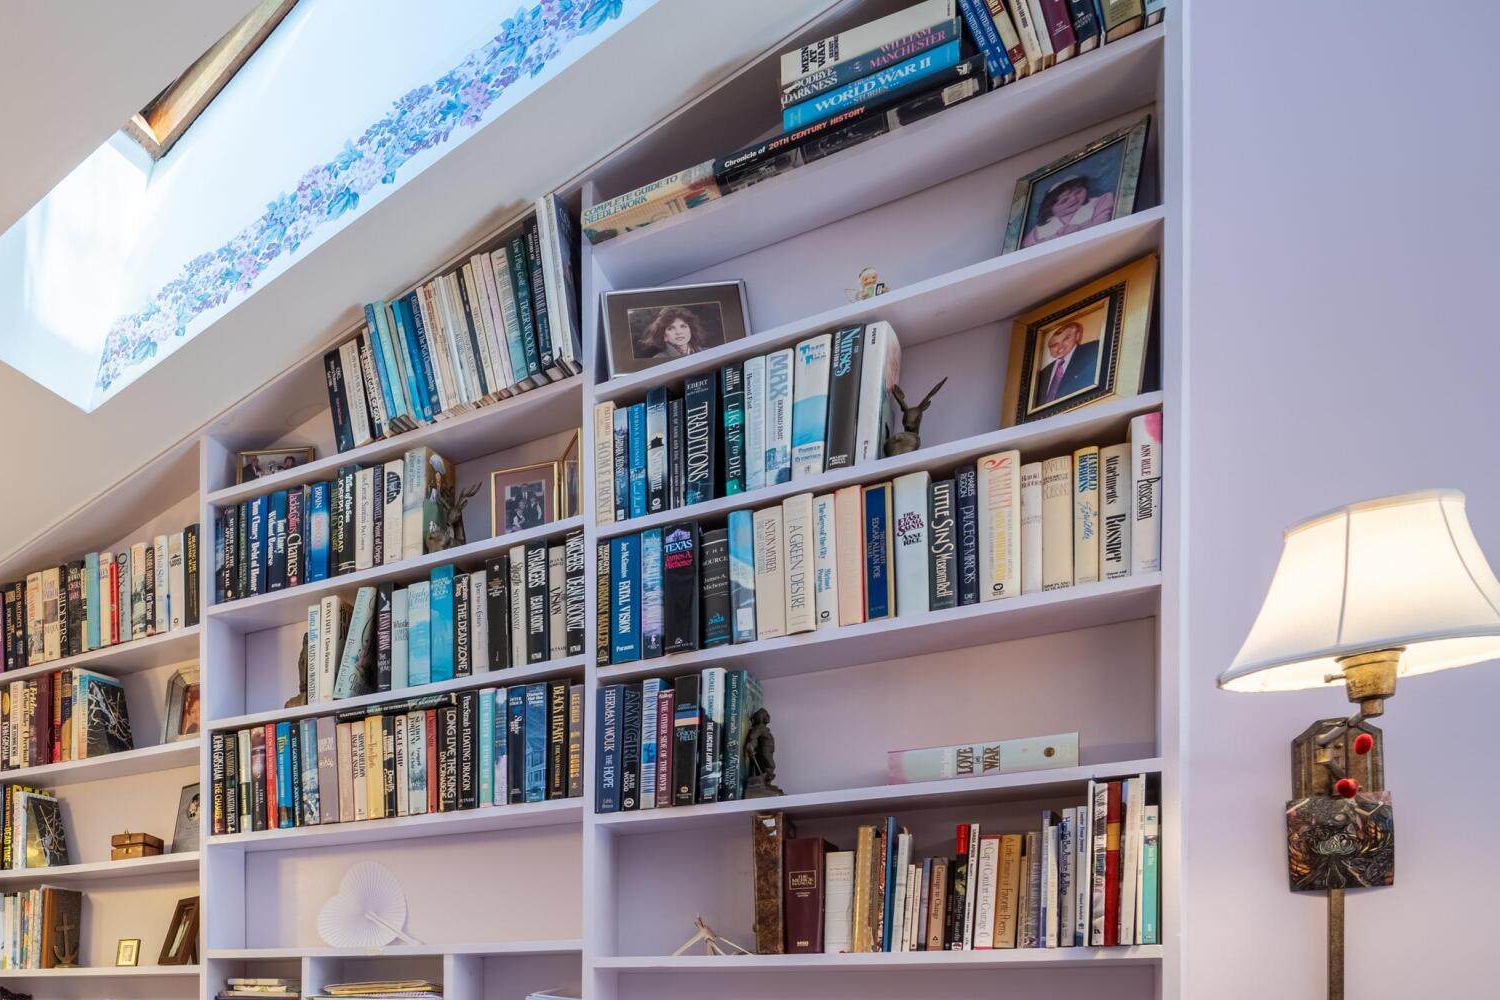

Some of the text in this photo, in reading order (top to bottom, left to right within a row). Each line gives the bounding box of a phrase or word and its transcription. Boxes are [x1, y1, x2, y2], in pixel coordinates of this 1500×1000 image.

[869, 30, 946, 68] MANCHESTER
[814, 80, 876, 112] WORLD
[879, 63, 917, 85] WAR
[724, 105, 866, 169] Chronicle of 20TH CENTURY HISTORY
[584, 175, 678, 217] COMPLETE GUIDE TO
[584, 195, 648, 225] NEEDLEWORK
[770, 354, 789, 400] MAX
[728, 402, 739, 442] LIKELY
[687, 401, 709, 483] TRADITIONS
[968, 471, 976, 496] CHARLES
[1088, 453, 1098, 491] HAROLD
[1137, 445, 1162, 521] ANN RULE Possession
[252, 499, 261, 515] Tom
[315, 486, 323, 509] BRAIN
[934, 484, 950, 518] LITTLE
[250, 516, 260, 540] Clancy
[276, 519, 286, 553] Tom Clancy
[960, 505, 975, 535] PALACE
[287, 533, 302, 577] Chances
[664, 540, 693, 553] TEXAS
[789, 533, 804, 572] GREEN
[1105, 514, 1127, 563] Rossner
[963, 548, 977, 584] MIRRORS
[528, 547, 546, 635] STRANGERS DEAN KOONTZ
[566, 575, 584, 632] DEAN KOONTZ
[619, 580, 631, 606] FATAL
[790, 572, 806, 611] DESIRE
[598, 575, 609, 649] NORMAN MAILER
[619, 606, 631, 634] VISION
[458, 602, 468, 672] THE DEAD ZONE
[708, 671, 716, 694] MICHAEL
[731, 674, 740, 689] Juan
[552, 685, 565, 744] BLACK HEART
[571, 693, 580, 705] LEE
[604, 689, 616, 725] HERMAN
[21, 730, 31, 764] Overload
[213, 735, 224, 752] JOHN
[446, 710, 457, 799] LONG LIVE THE KING
[462, 728, 472, 752] FLOATING
[603, 726, 615, 753] WOUK
[705, 721, 715, 773] THE LINCOLN LAWYER
[213, 752, 224, 781] GRISHAM
[439, 751, 447, 763] LYN
[462, 752, 472, 781] DRAGON
[956, 746, 974, 776] LOVE
[982, 744, 1001, 773] WAR
[603, 766, 614, 790] HOPE
[3, 826, 12, 863] DEAD TIME
[935, 866, 944, 889] Courage
[1000, 887, 1013, 913] Favorite
[998, 914, 1012, 937] Poems
